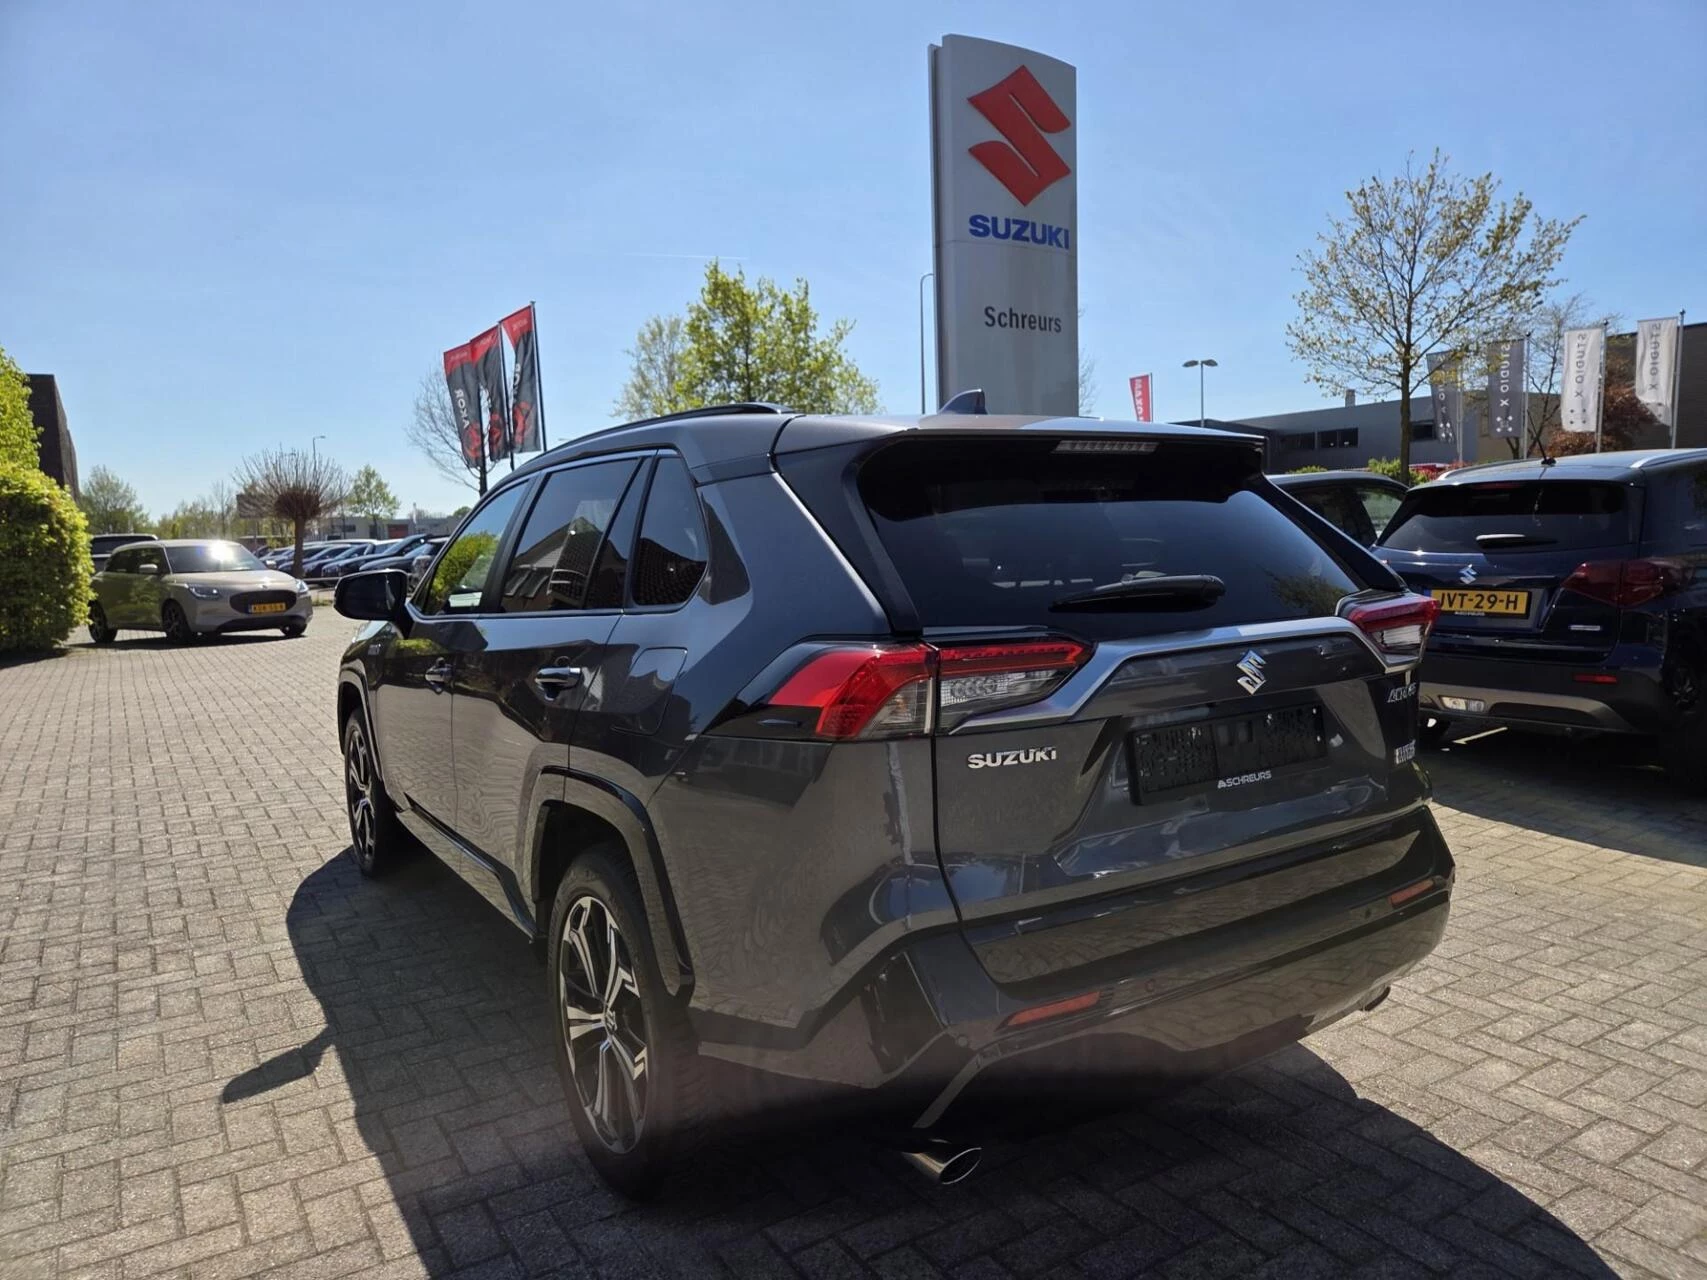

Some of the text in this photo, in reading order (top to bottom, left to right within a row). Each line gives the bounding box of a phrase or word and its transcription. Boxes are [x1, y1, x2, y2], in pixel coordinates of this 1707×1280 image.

[968, 214, 1070, 250] SUZUKI
[984, 306, 1062, 333] Schreurs
[1438, 592, 1519, 611] JVT-29-H
[968, 746, 1057, 769] SUZUKI
